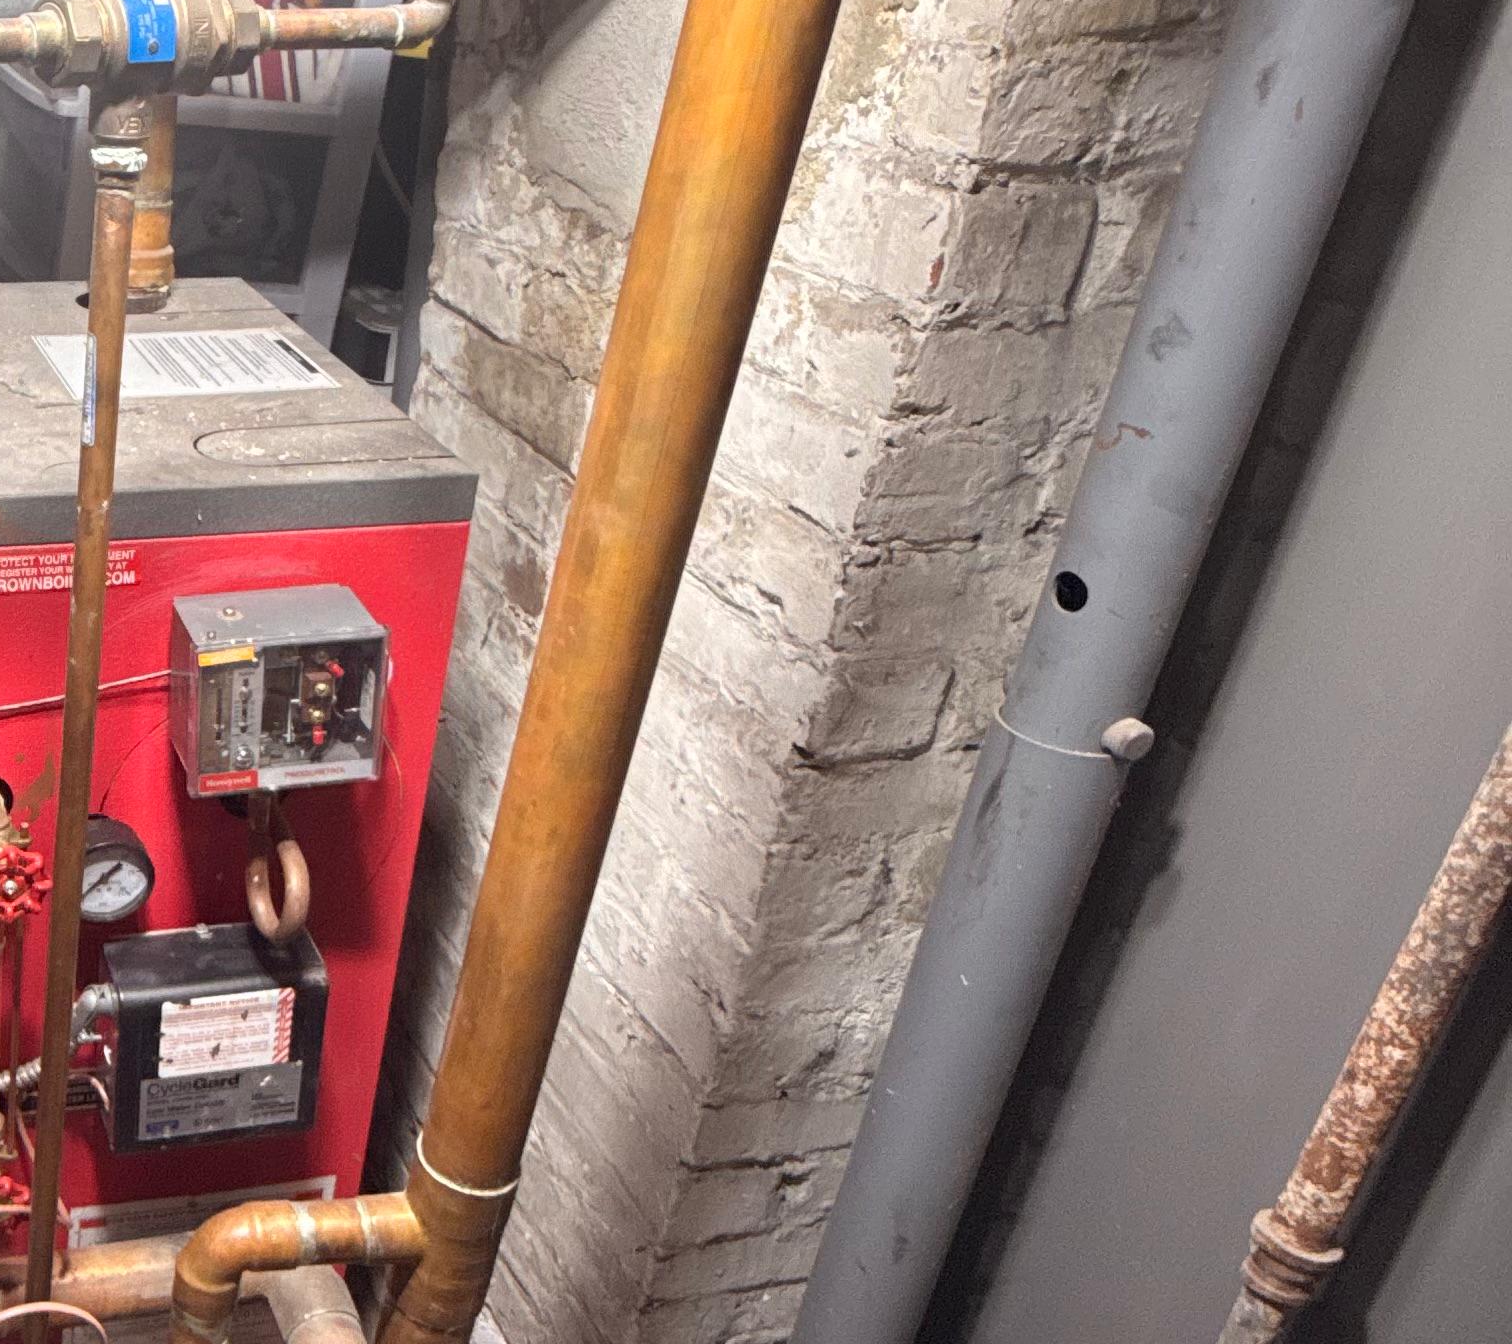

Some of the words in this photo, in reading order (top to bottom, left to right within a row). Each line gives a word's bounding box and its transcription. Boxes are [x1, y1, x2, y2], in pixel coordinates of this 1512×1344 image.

[38, 554, 68, 565] YOUR
[39, 566, 63, 575] YOUR
[115, 561, 127, 570] AT
[205, 774, 252, 788] Honeywell
[147, 1072, 241, 1098] CycleGard
